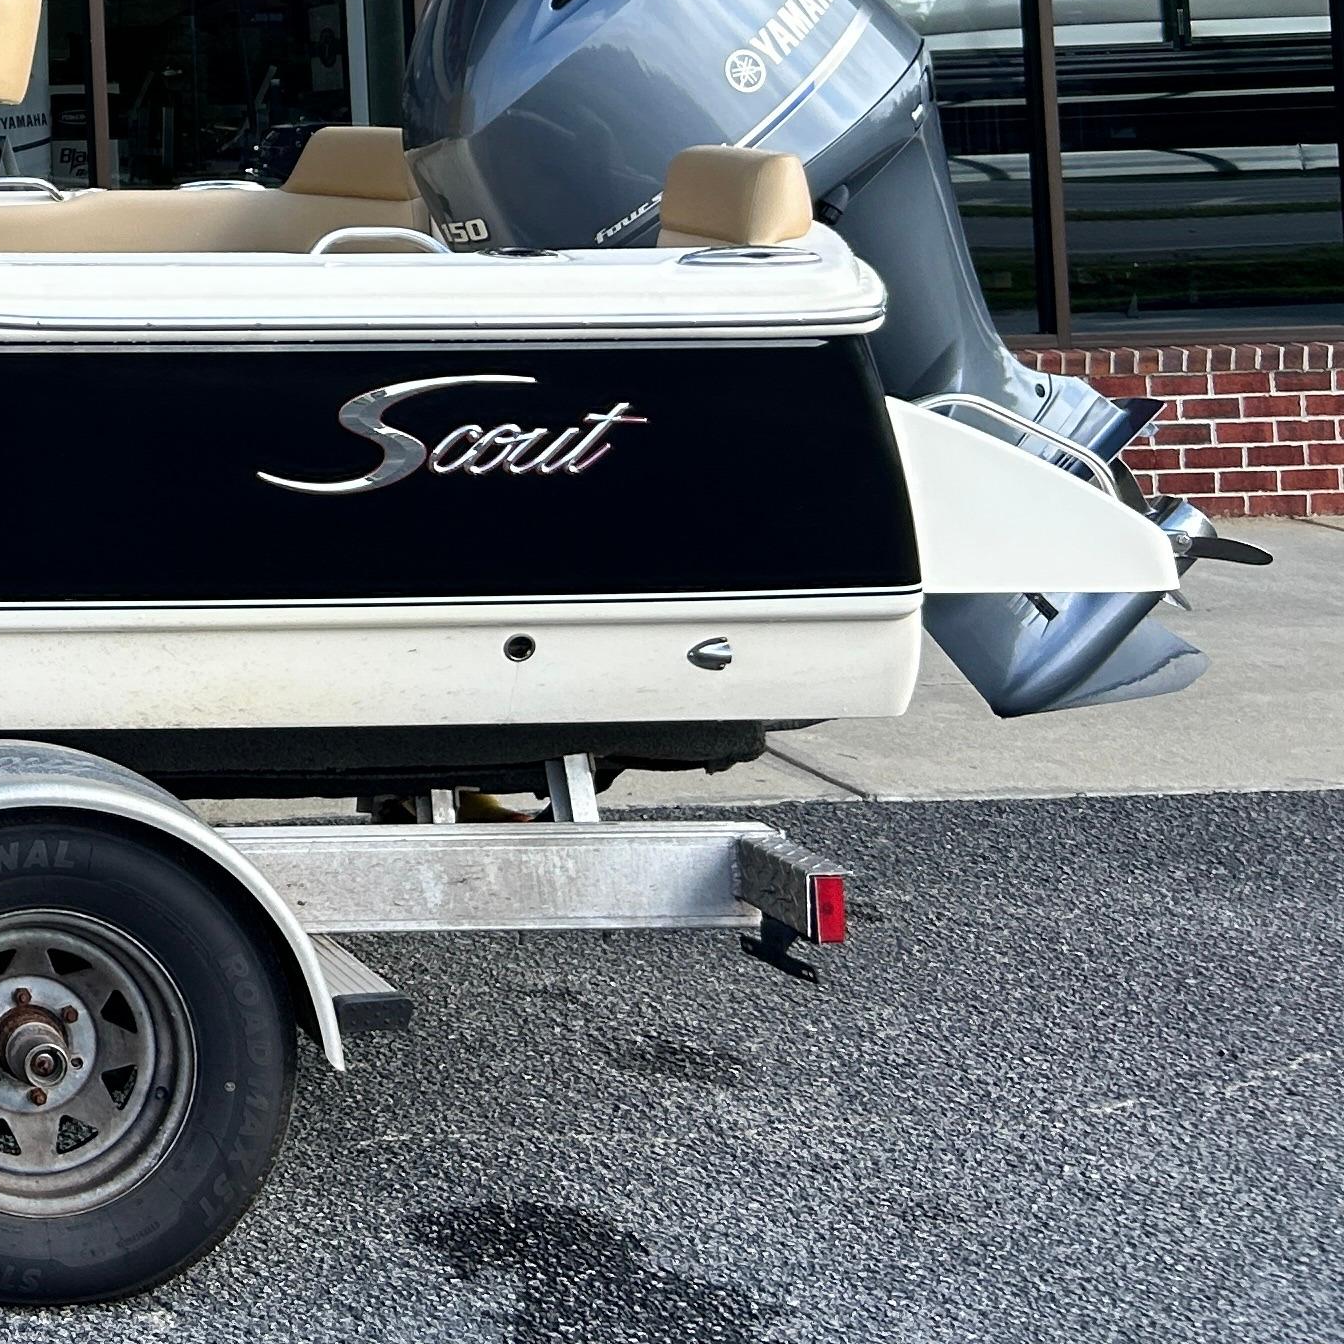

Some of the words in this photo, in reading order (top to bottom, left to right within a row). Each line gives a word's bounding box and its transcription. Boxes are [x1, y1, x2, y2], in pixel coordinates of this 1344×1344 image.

[0, 112, 49, 130] YAMAHA
[440, 217, 490, 244] 150
[256, 373, 649, 496] Scout
